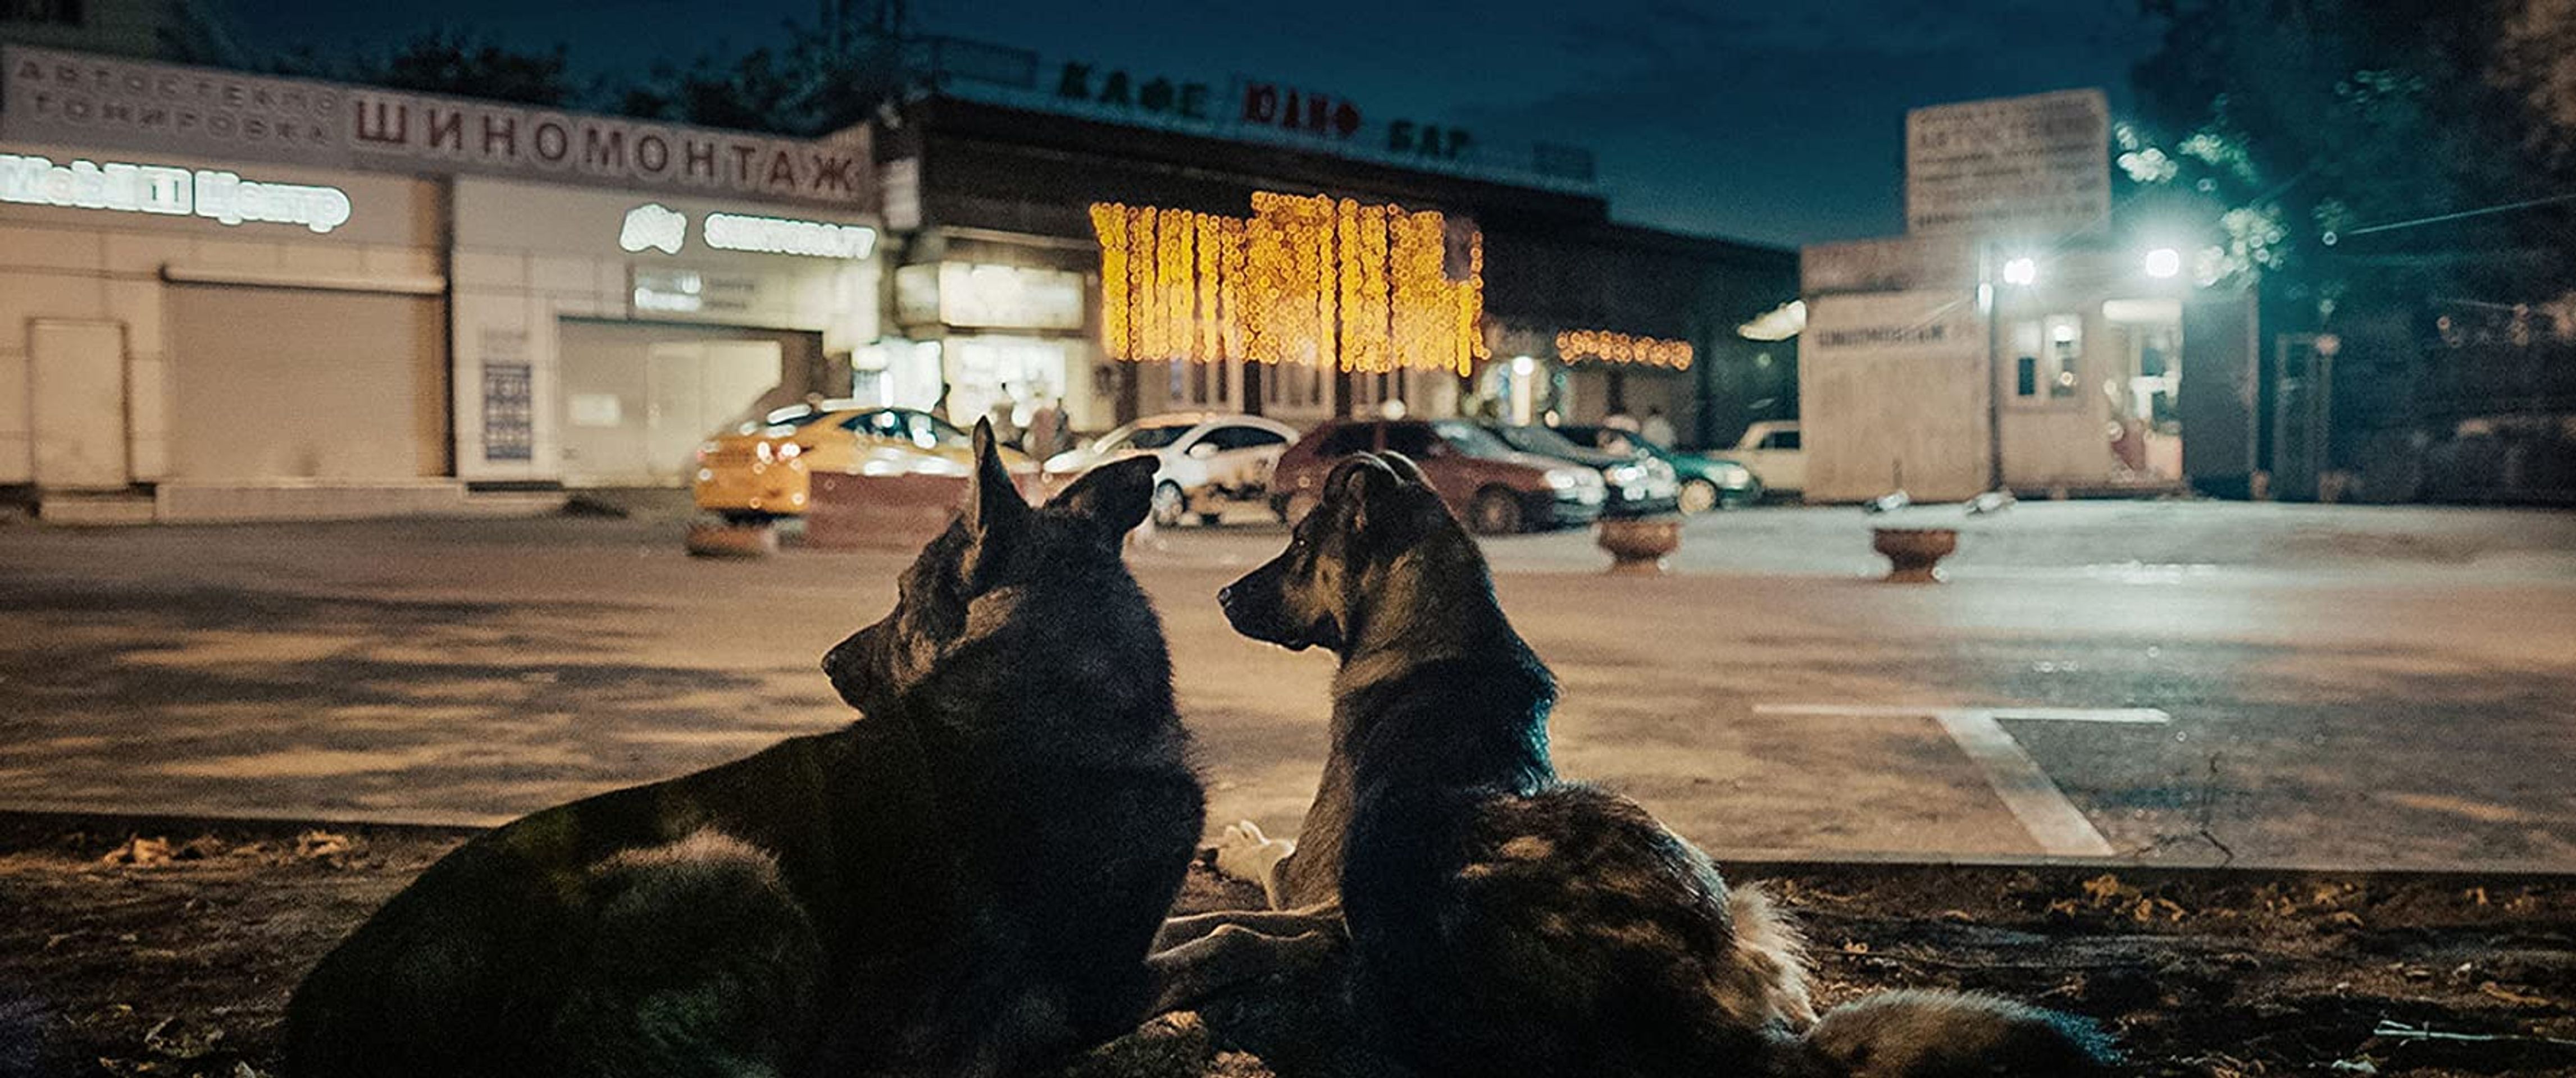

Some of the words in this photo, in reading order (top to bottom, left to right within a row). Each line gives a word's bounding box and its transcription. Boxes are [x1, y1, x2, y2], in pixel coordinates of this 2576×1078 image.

[19, 60, 338, 113] АВТОСТЕКЛО
[1058, 61, 1208, 118] КАФЕ
[34, 92, 329, 140] ТОНИРОВКА
[357, 99, 854, 193] ШИНОМОНТАЖ
